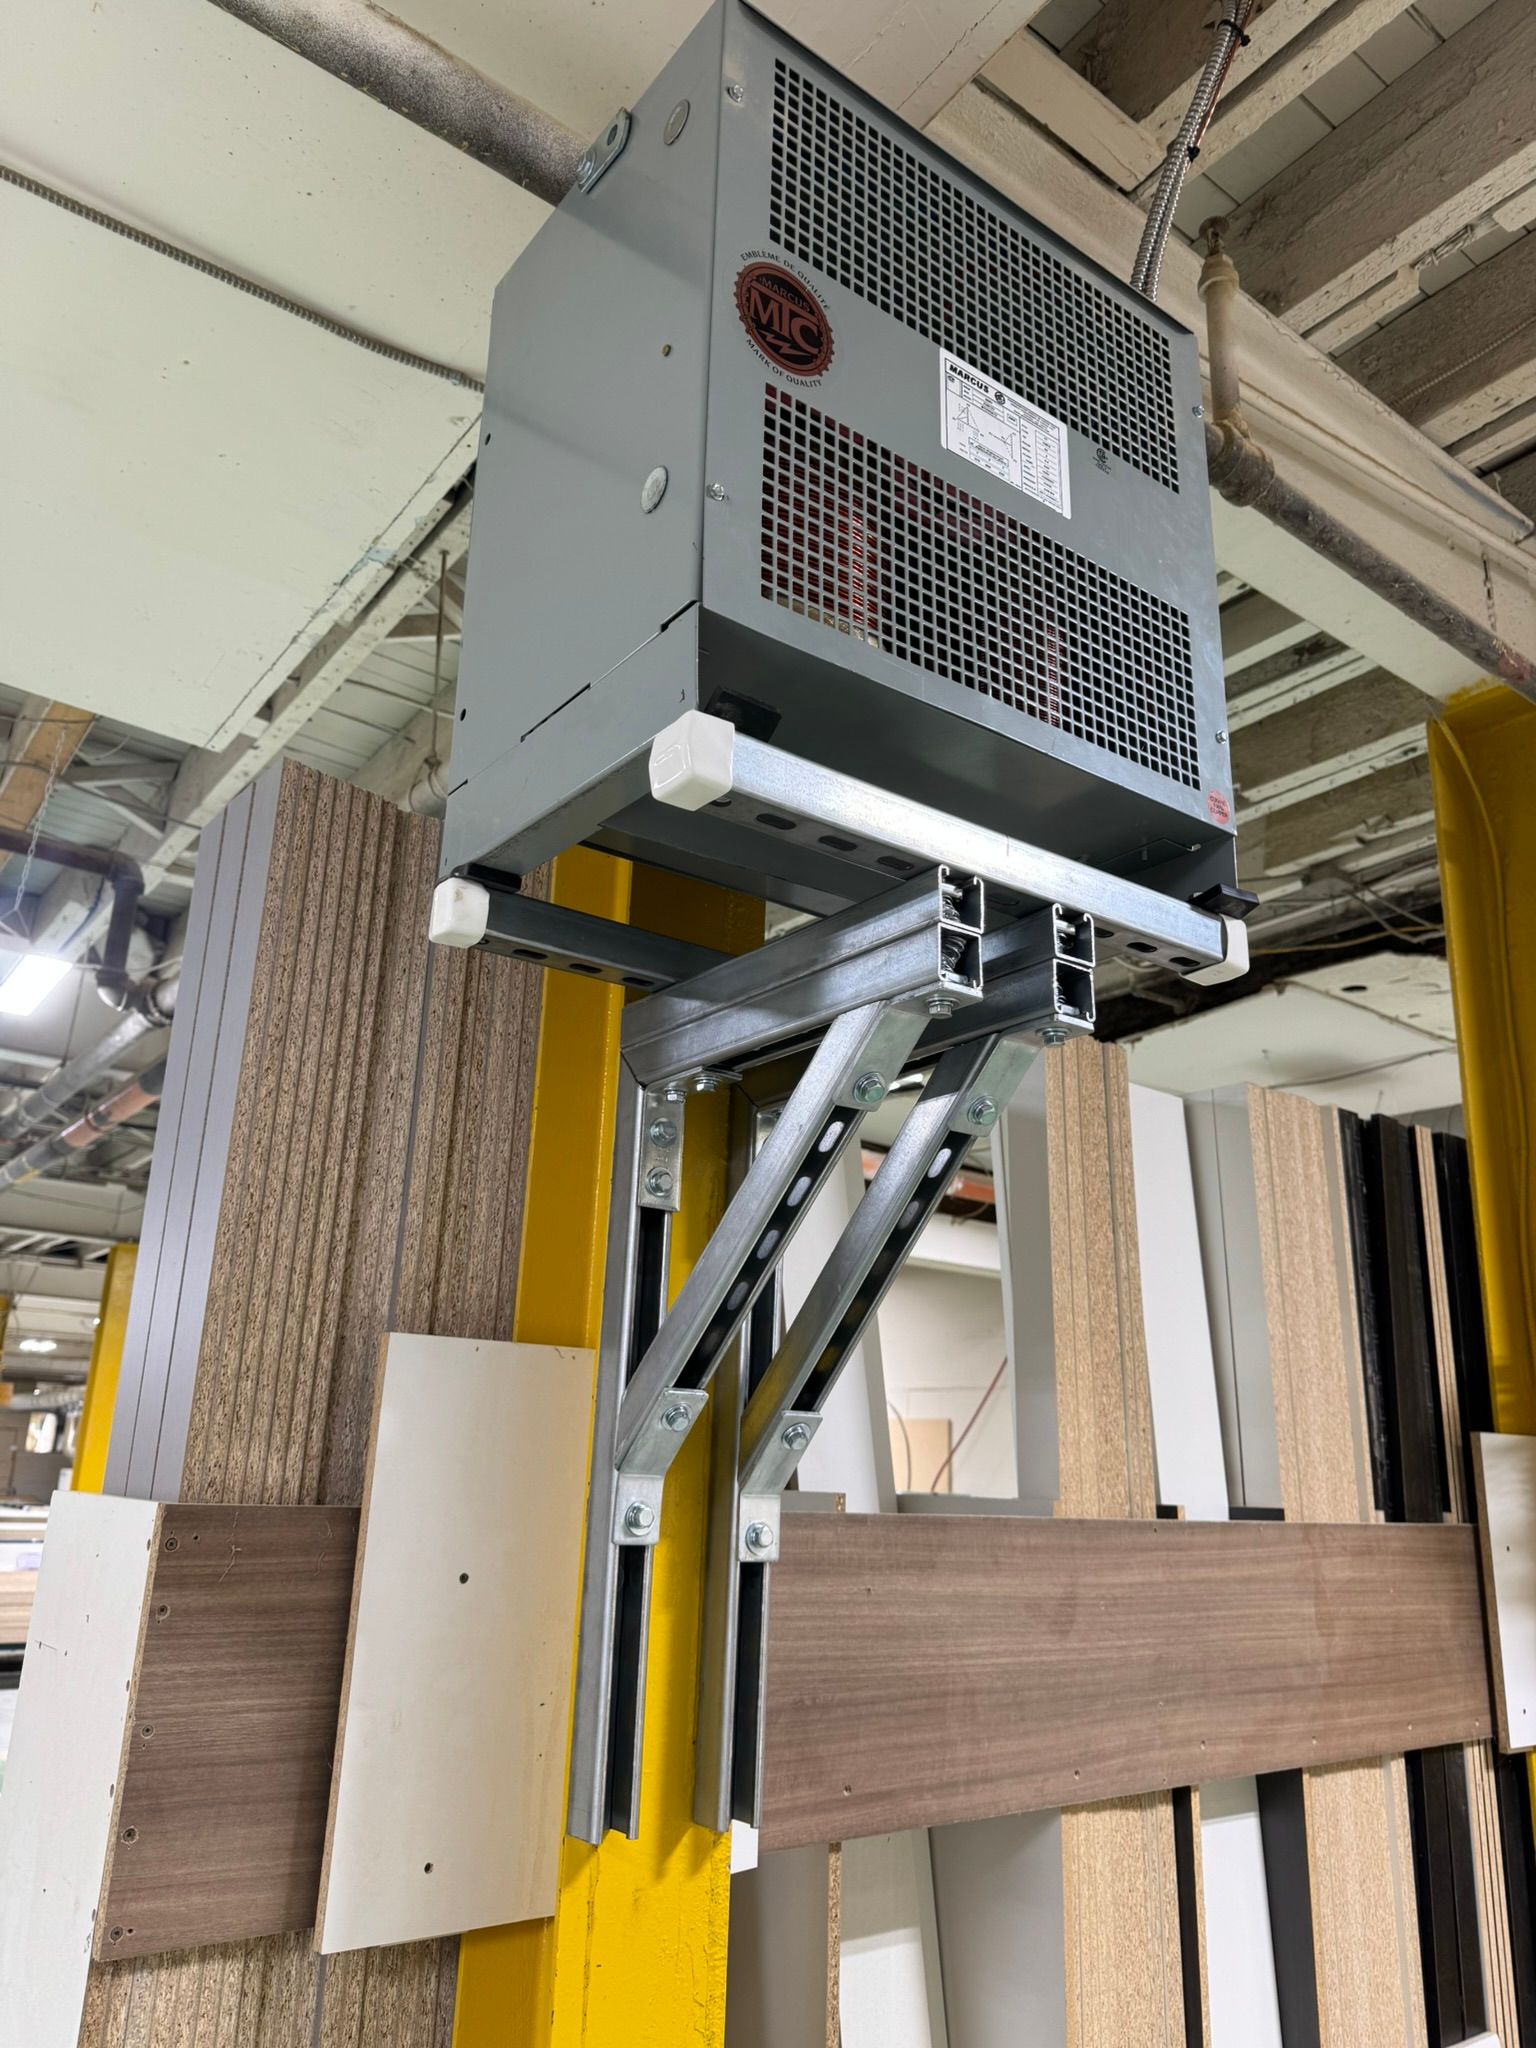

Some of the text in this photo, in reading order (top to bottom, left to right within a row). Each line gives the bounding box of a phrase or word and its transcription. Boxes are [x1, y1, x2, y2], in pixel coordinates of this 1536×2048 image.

[783, 259, 796, 273] DE
[761, 277, 811, 312] MARCUS
[749, 280, 820, 356] MTC
[746, 338, 823, 388] MARK OF QUALITY
[949, 364, 989, 393] MARCUS
